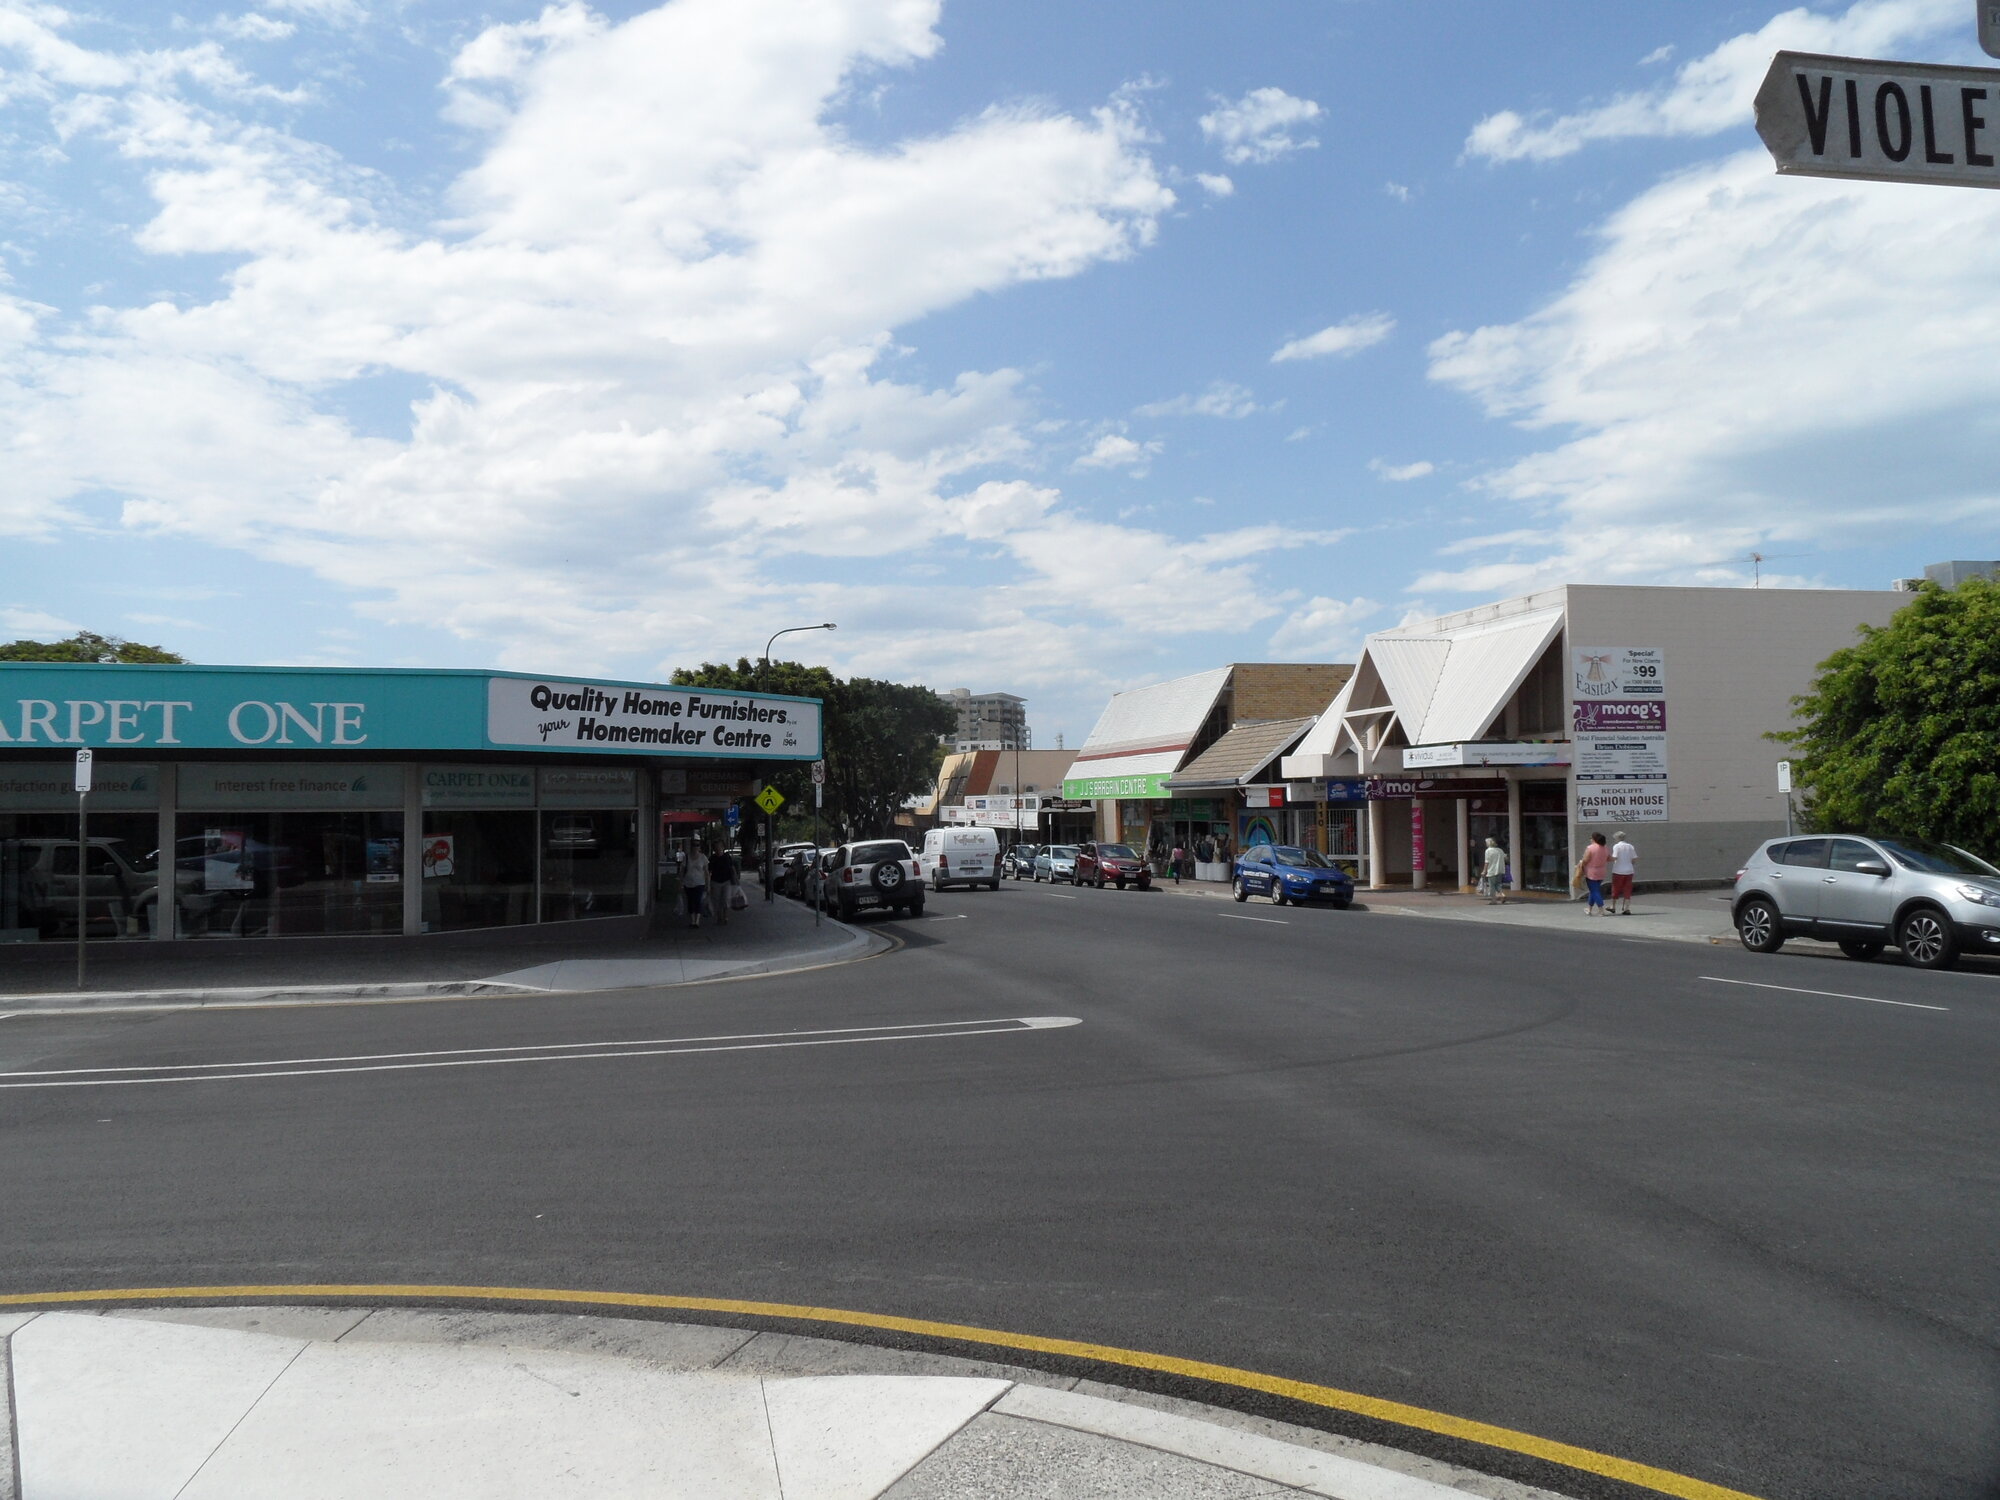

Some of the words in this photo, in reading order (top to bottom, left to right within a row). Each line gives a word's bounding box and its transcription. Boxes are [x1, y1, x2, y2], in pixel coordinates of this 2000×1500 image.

[1796, 73, 2000, 167] VIOLE
[1633, 665, 1657, 678] $99
[1576, 672, 1618, 696] Easitax
[530, 685, 618, 717] Quality
[622, 691, 682, 717] Home
[686, 696, 787, 724] Furnishers
[1602, 702, 1661, 719] morag's
[228, 702, 367, 745] ONE
[538, 720, 570, 742] your
[576, 717, 706, 745] Homemaker
[712, 725, 772, 748] Centre
[79, 753, 91, 763] 2P
[60, 780, 128, 795] guantee
[214, 779, 266, 793] Interest
[269, 778, 296, 793] free
[299, 778, 348, 793] finance
[426, 772, 484, 787] CARPET
[487, 773, 520, 787] ONE
[1581, 796, 1626, 806] FASHION
[1629, 795, 1664, 805] HOUSE
